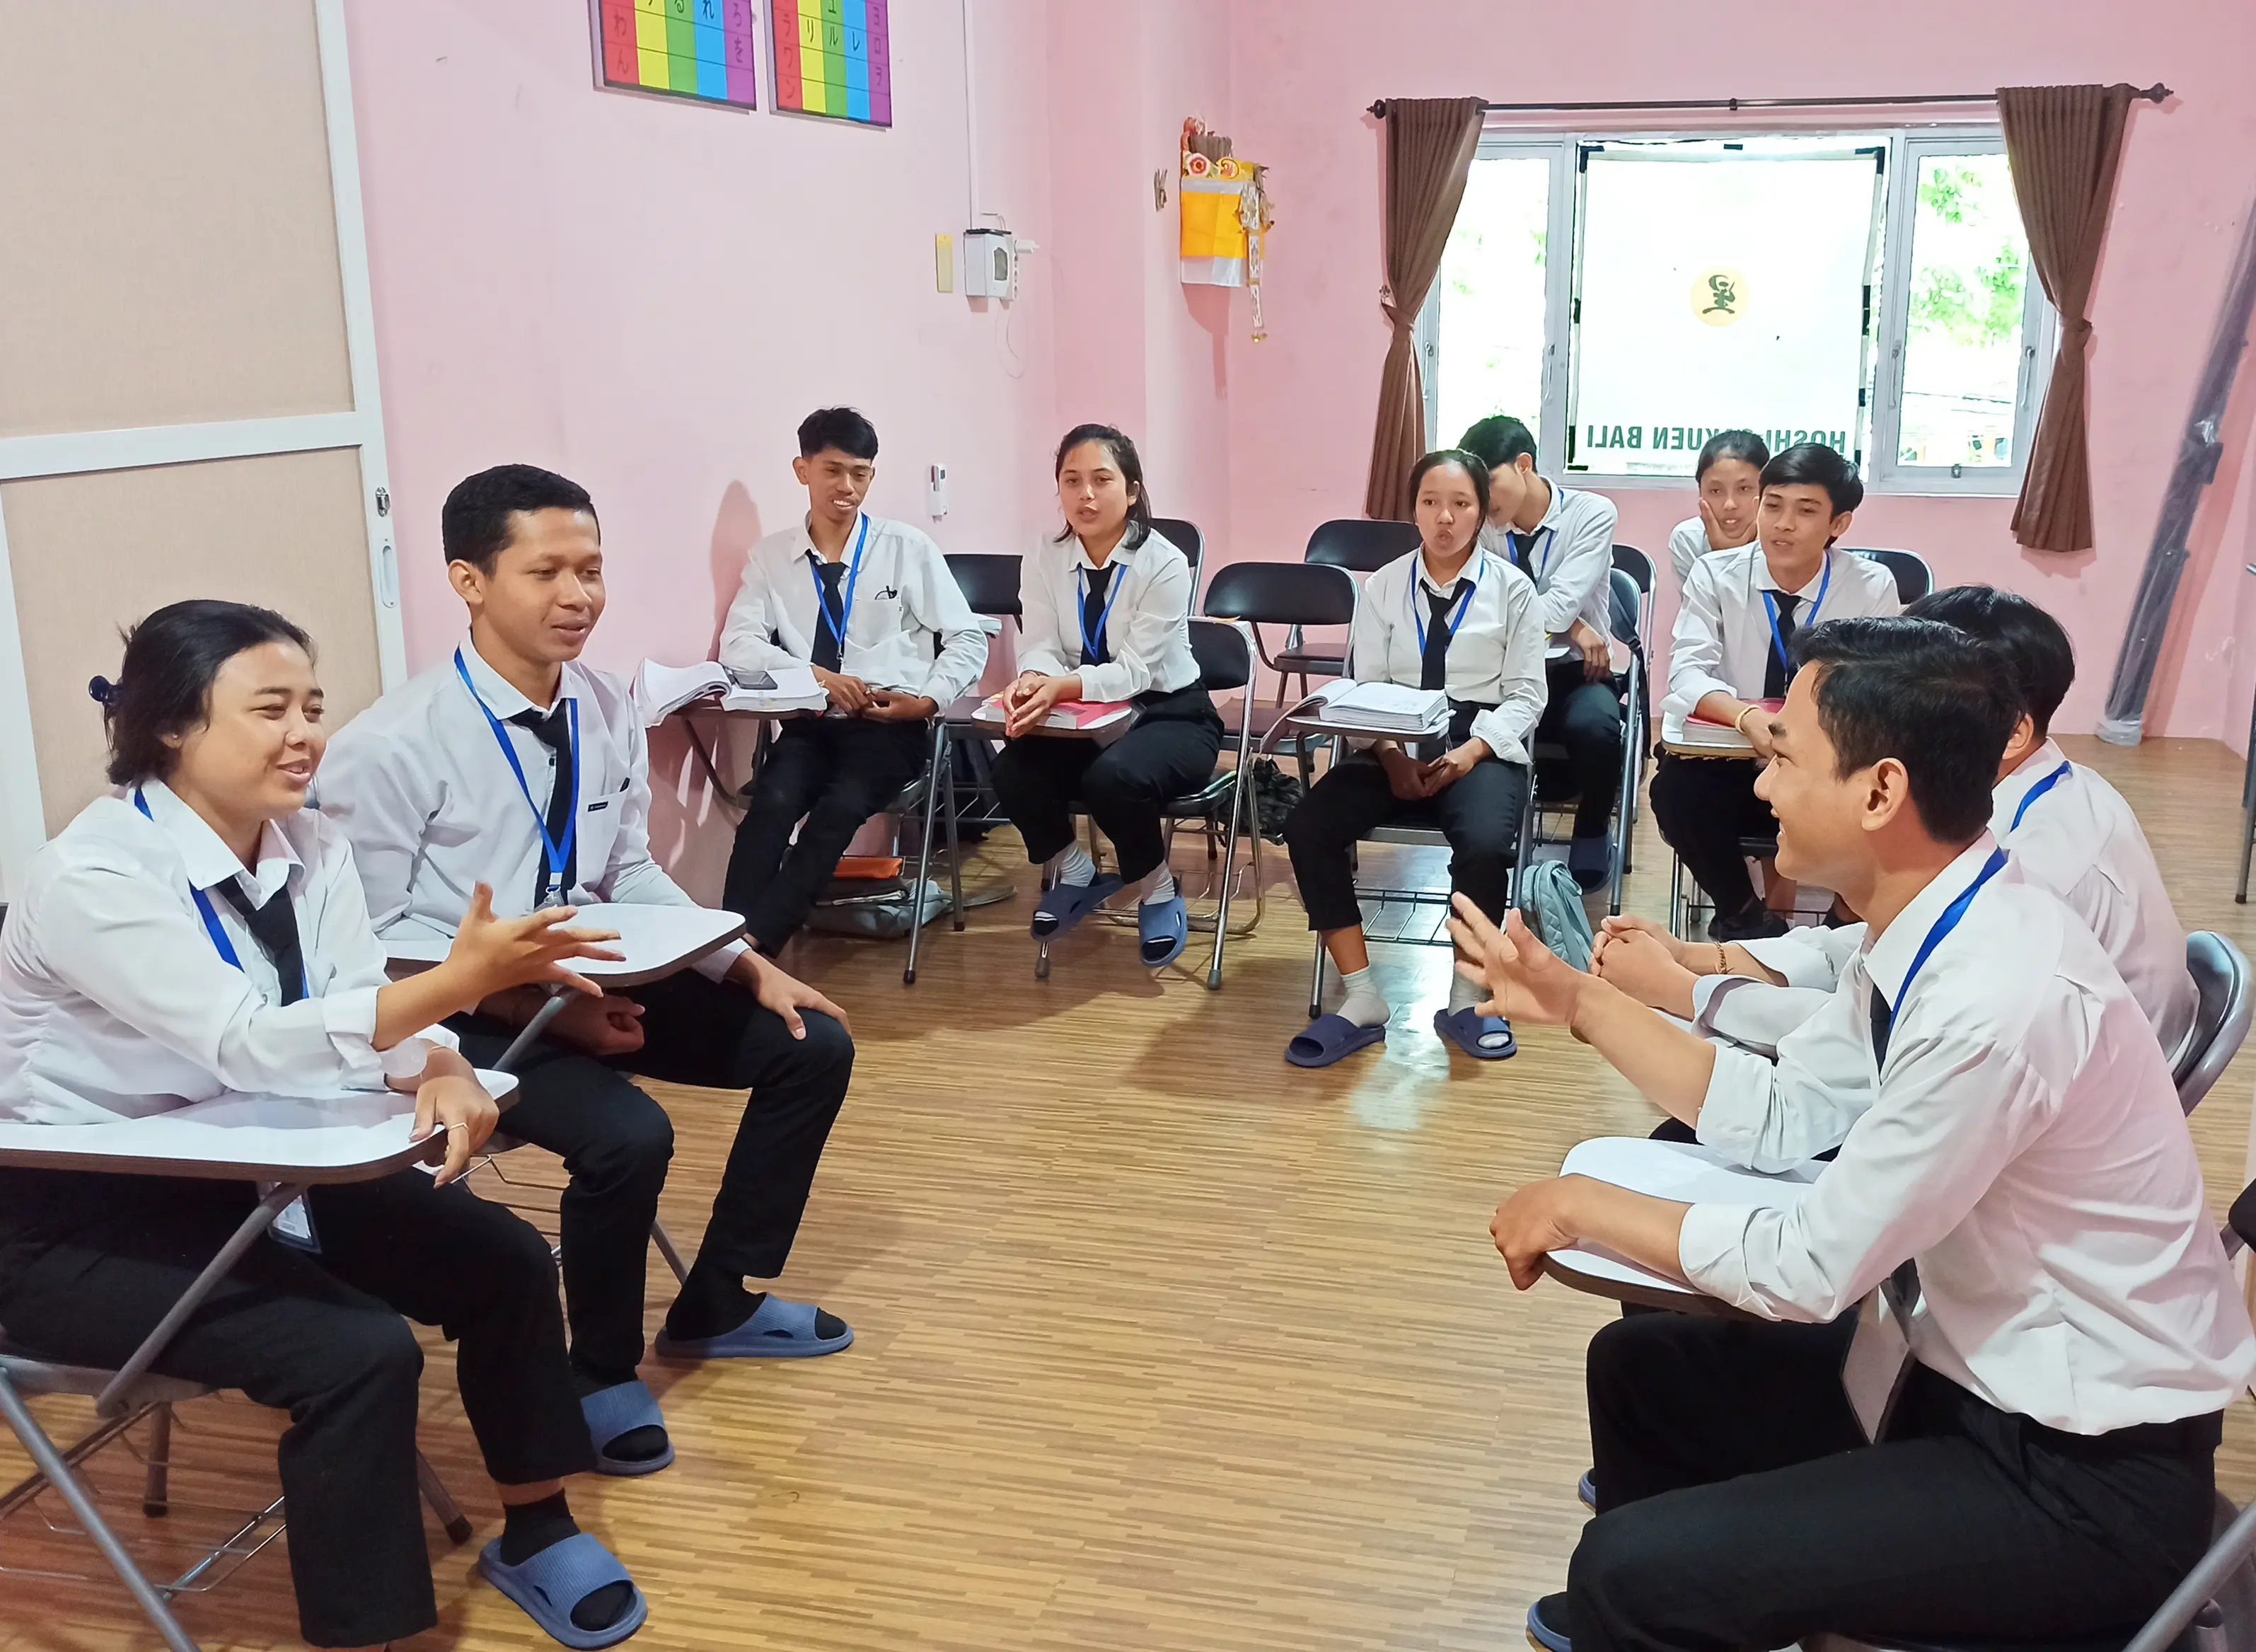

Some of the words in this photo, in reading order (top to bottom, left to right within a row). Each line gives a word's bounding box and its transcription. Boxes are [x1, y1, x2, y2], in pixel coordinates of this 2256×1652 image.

[614, 8, 627, 37] わ
[829, 25, 838, 46] ル
[617, 49, 629, 75] ん
